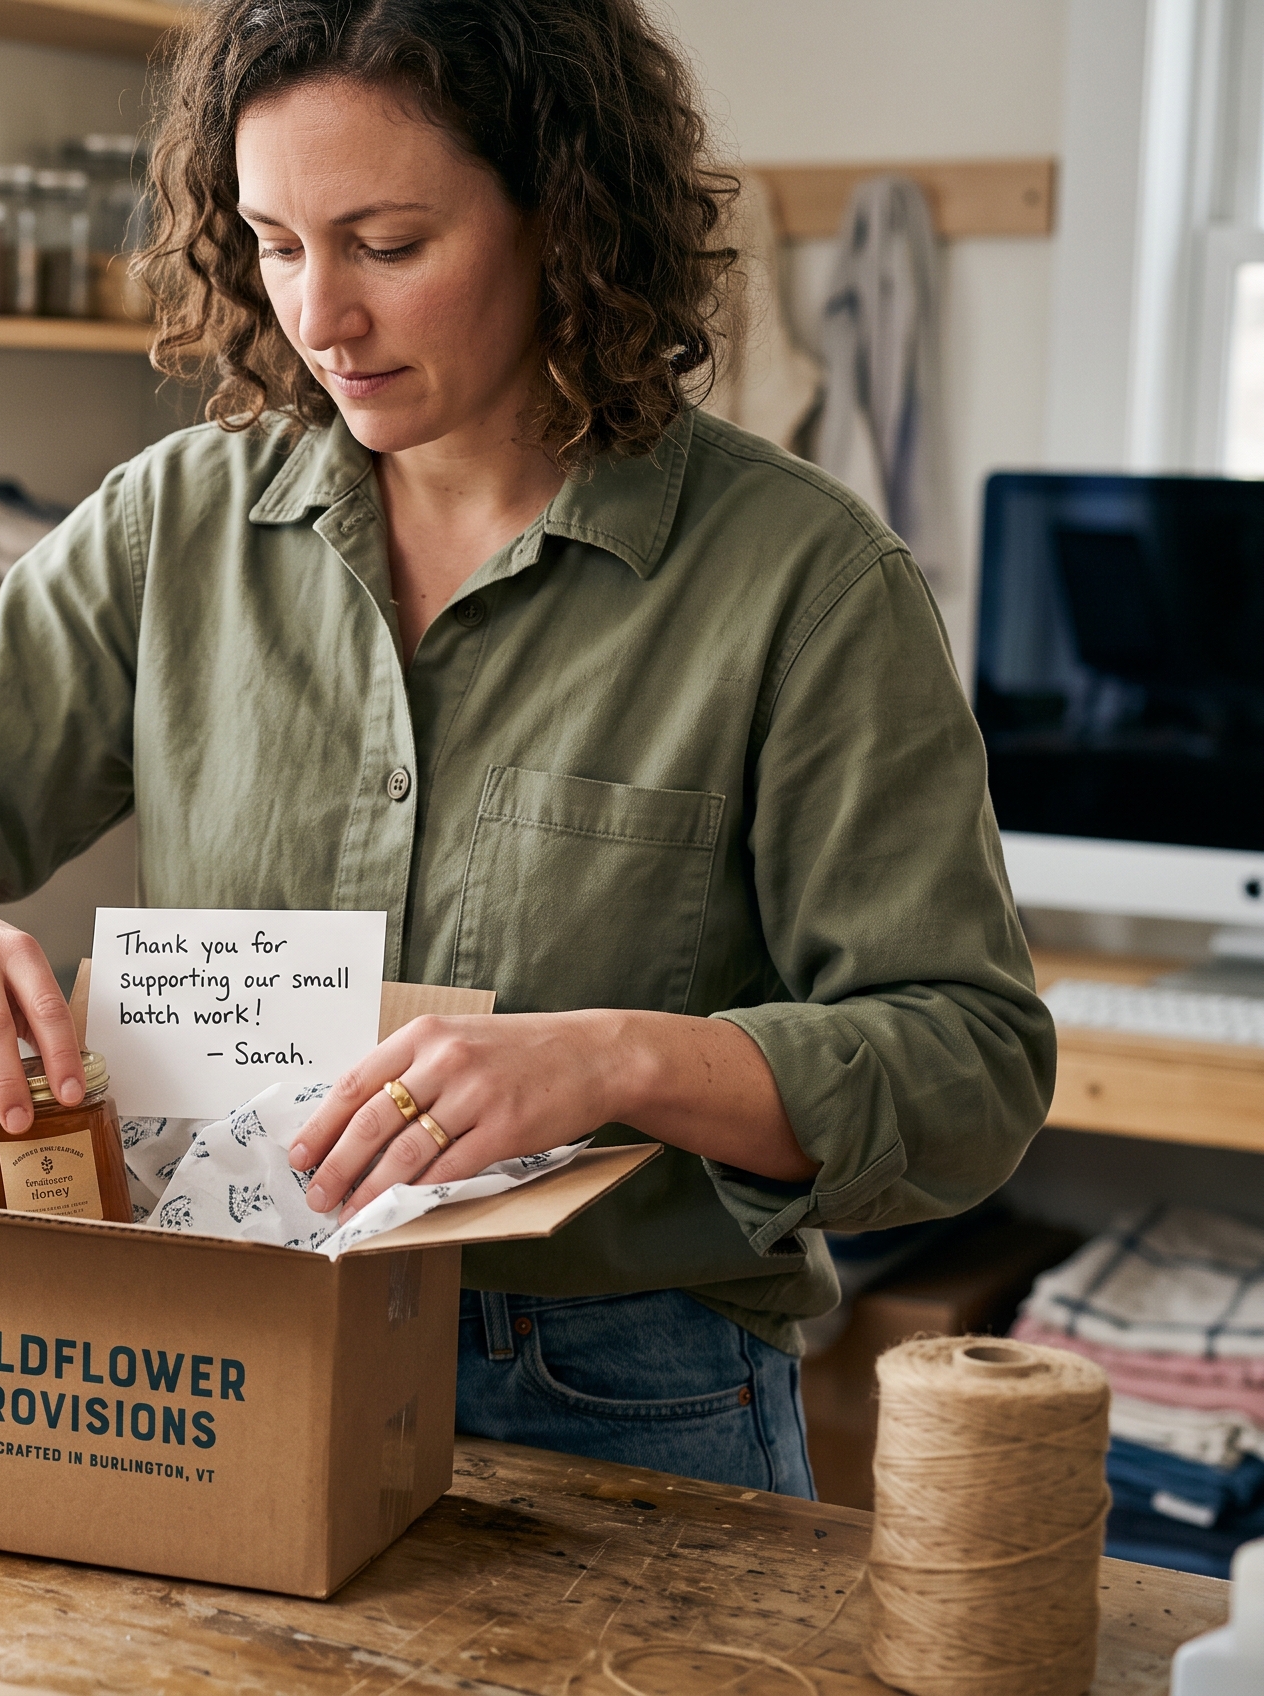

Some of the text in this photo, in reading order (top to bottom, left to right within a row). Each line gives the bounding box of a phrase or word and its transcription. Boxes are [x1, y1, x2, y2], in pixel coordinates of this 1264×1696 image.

[116, 929, 288, 964] Thank you for
[120, 966, 349, 1002] supporting our small
[120, 998, 261, 1026] batch work!
[235, 1041, 313, 1066] Sarah.
[68, 1450, 83, 1466] IN
[89, 1453, 190, 1482] BURLINGTON,
[195, 1467, 215, 1484] VT
